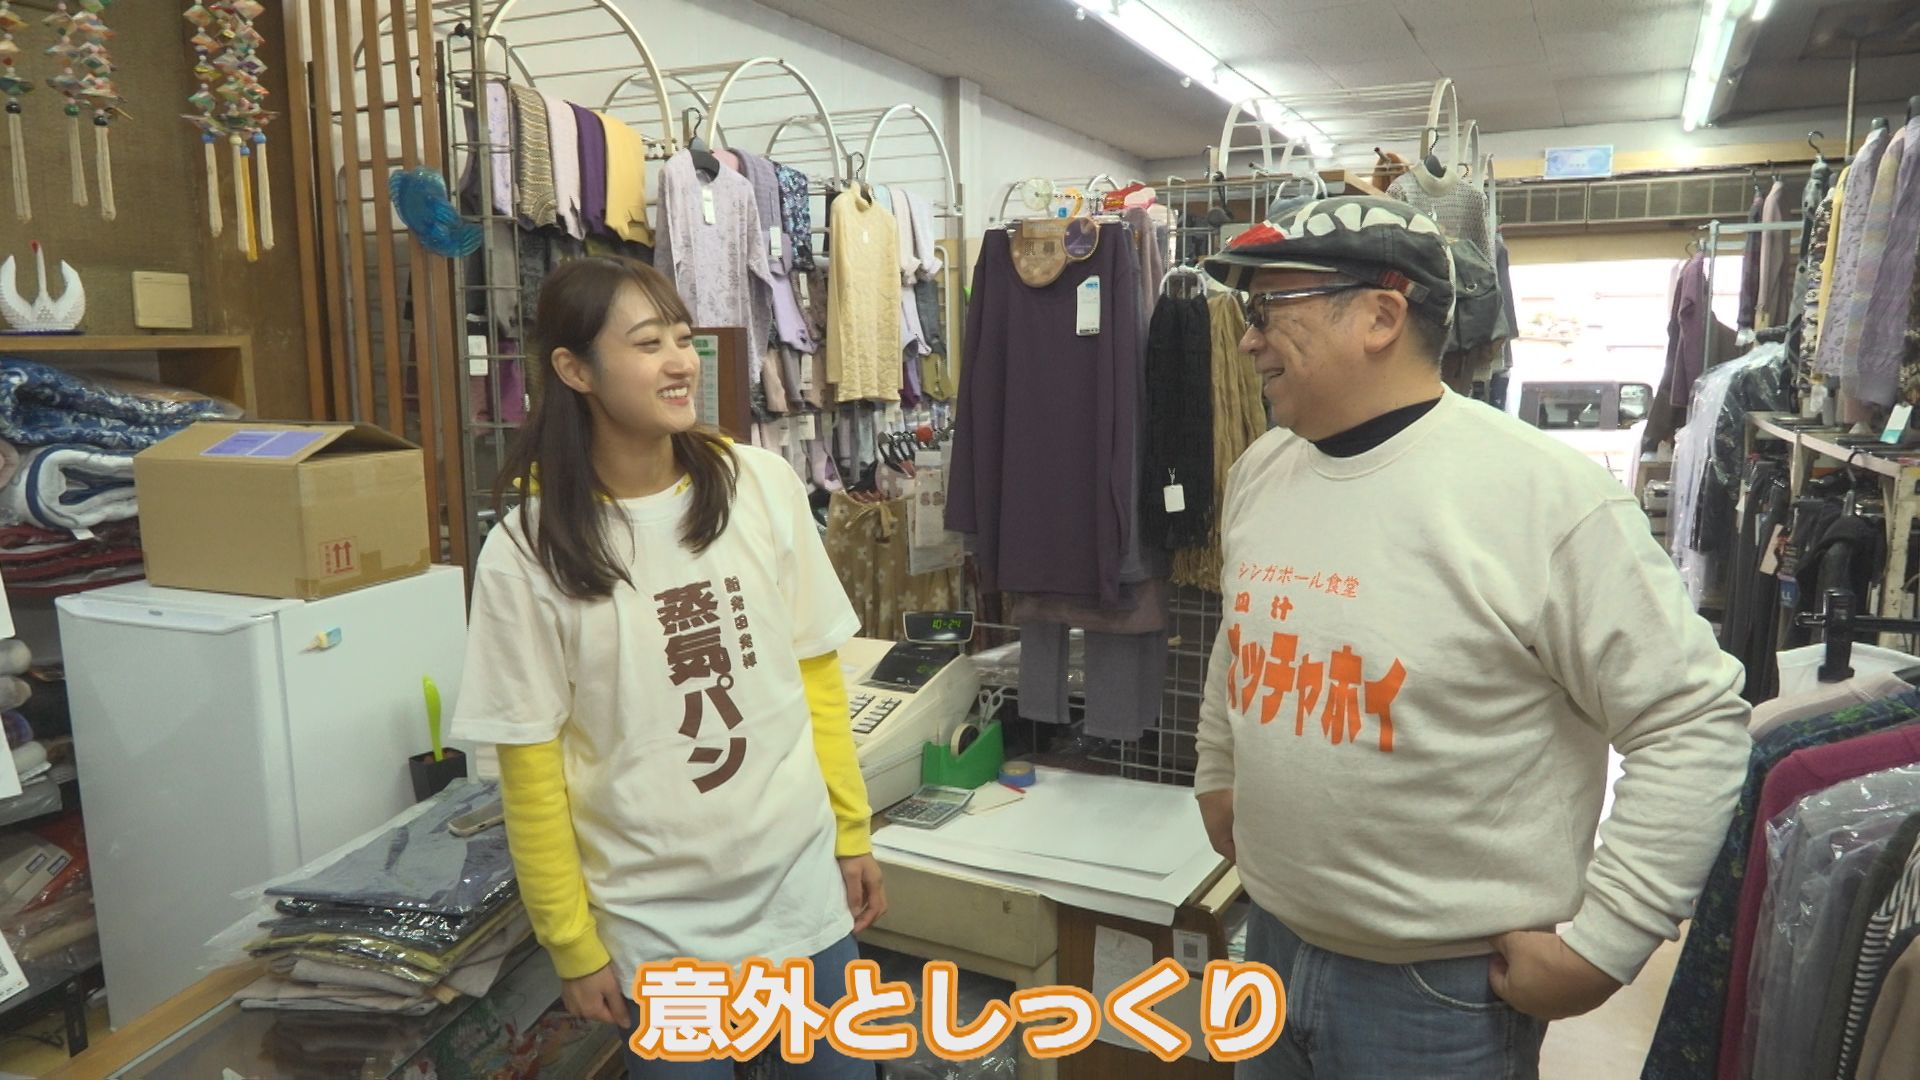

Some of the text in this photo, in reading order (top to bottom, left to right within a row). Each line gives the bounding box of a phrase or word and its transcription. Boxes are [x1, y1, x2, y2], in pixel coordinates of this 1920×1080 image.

[1238, 562, 1360, 598] シンガポール食堂
[653, 579, 747, 794] 蒸気パン
